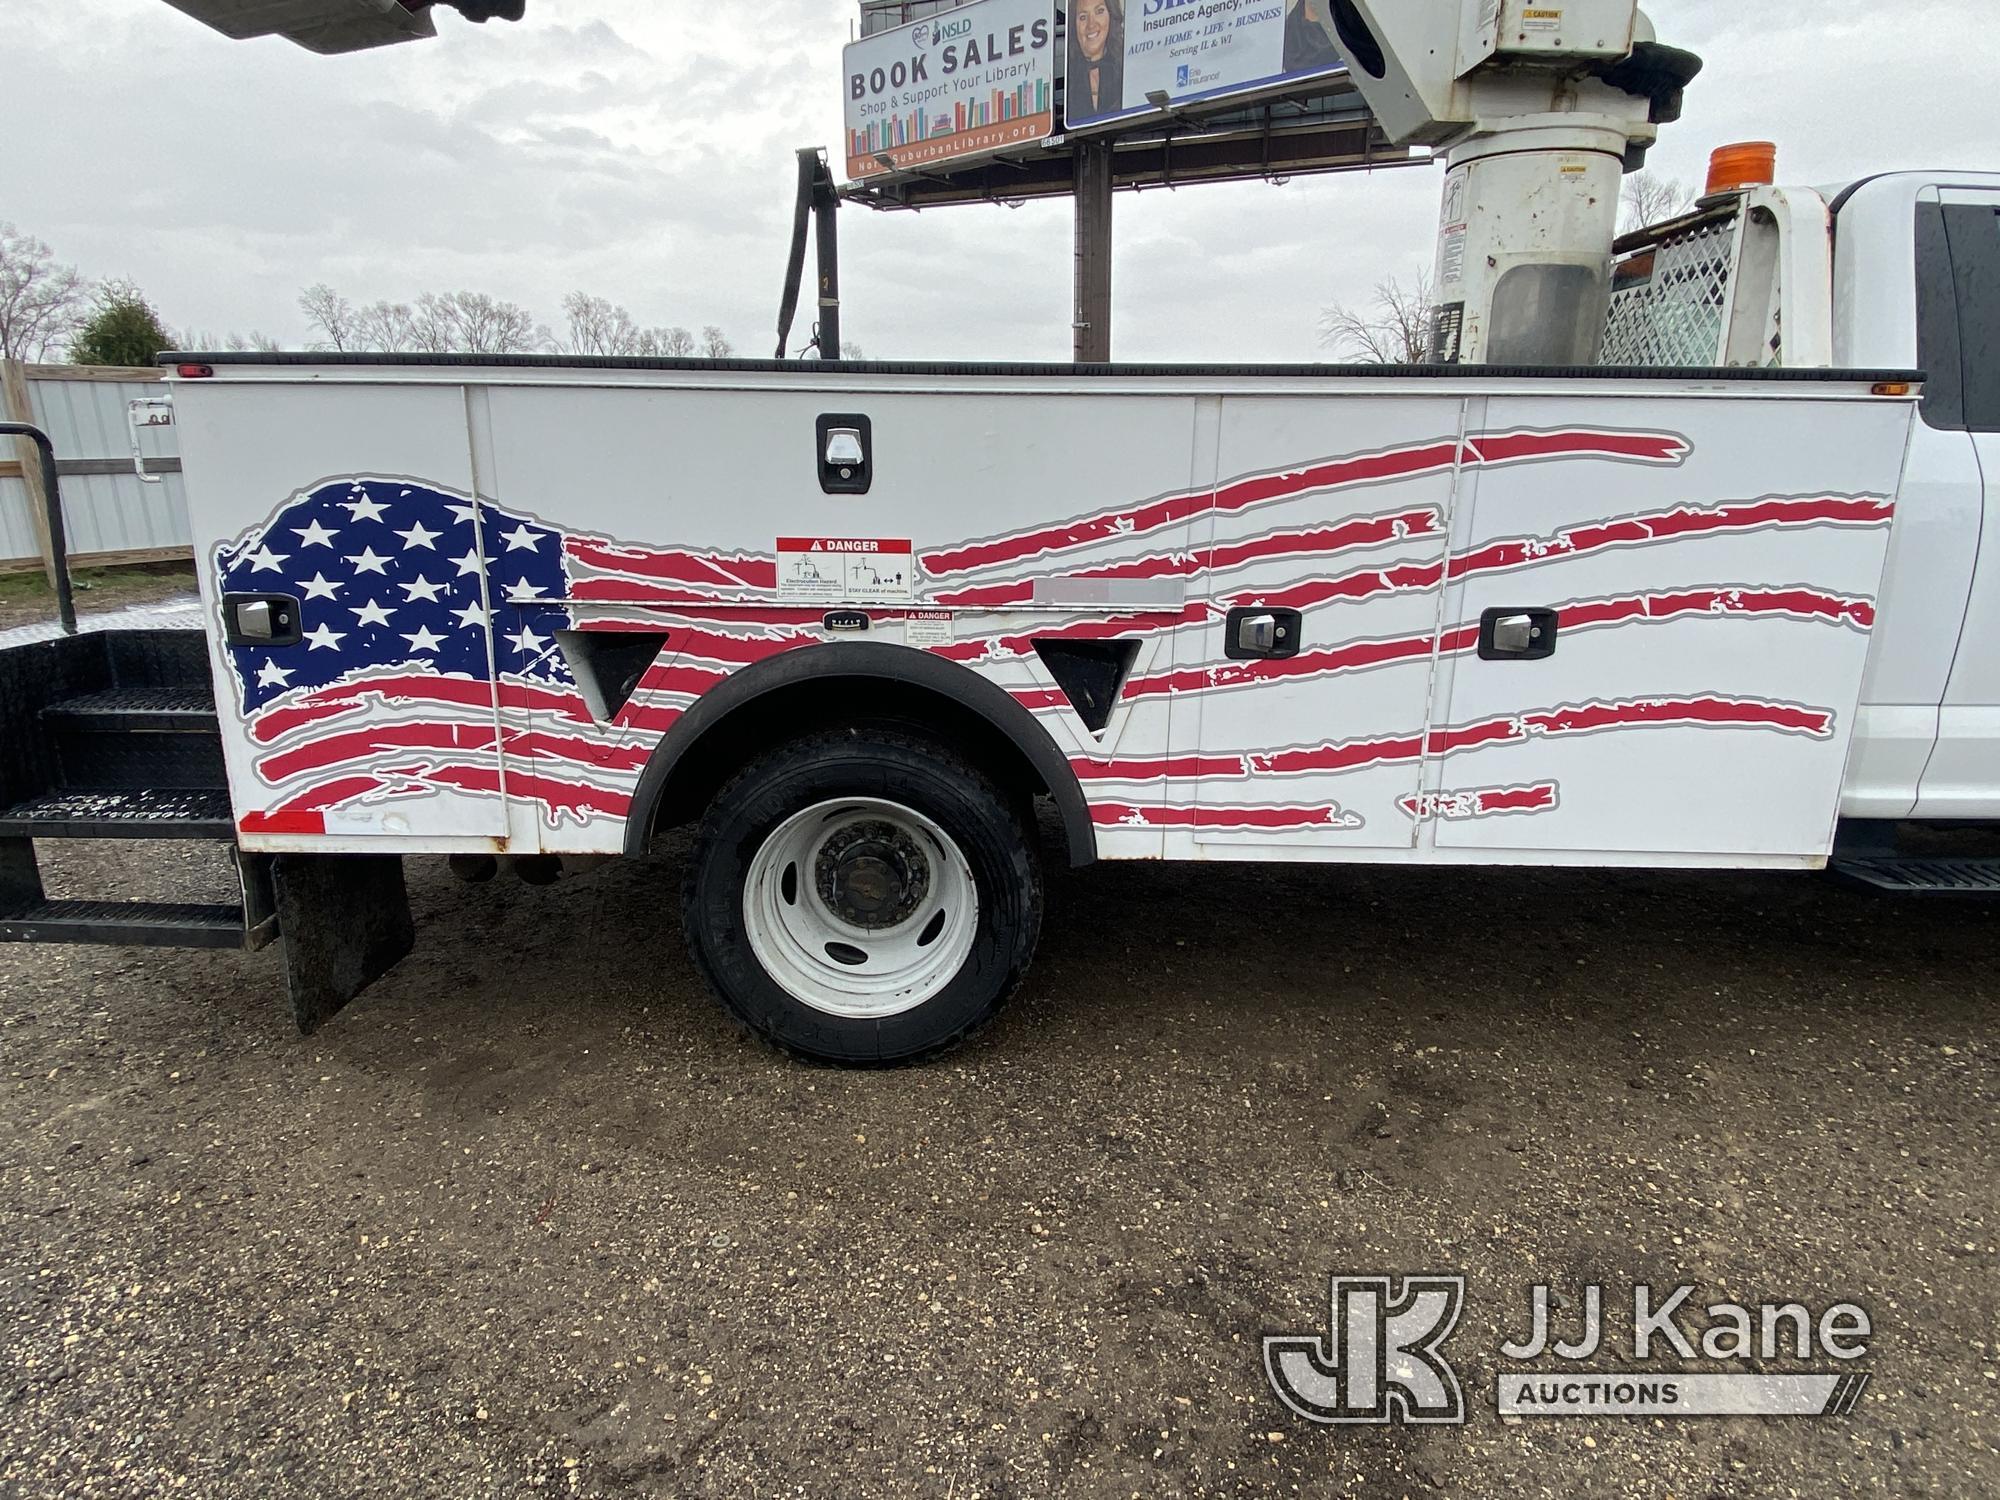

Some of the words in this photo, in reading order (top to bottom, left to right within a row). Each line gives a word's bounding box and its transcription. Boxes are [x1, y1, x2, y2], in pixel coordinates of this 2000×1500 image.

[942, 19, 972, 39] NSLD
[1128, 40, 1154, 56] AUTO
[1164, 30, 1193, 46] HOME
[1203, 22, 1224, 36] LIFE
[1235, 7, 1282, 28] BUSINESS
[1143, 10, 1195, 32] Insurance
[1197, 0, 1242, 18] Agency,
[851, 53, 929, 100] BOOK
[942, 18, 1048, 74] SALES
[1169, 45, 1199, 58] Serving
[1200, 40, 1209, 51] IL
[860, 102, 887, 117] Shop
[891, 95, 898, 108] &
[903, 82, 949, 105] Support
[953, 75, 981, 92] Your
[985, 57, 1035, 83] Library!
[858, 124, 1036, 172] NorSuburbanLibrary.org
[826, 540, 879, 552] DANGER
[918, 612, 950, 620] DANGER
